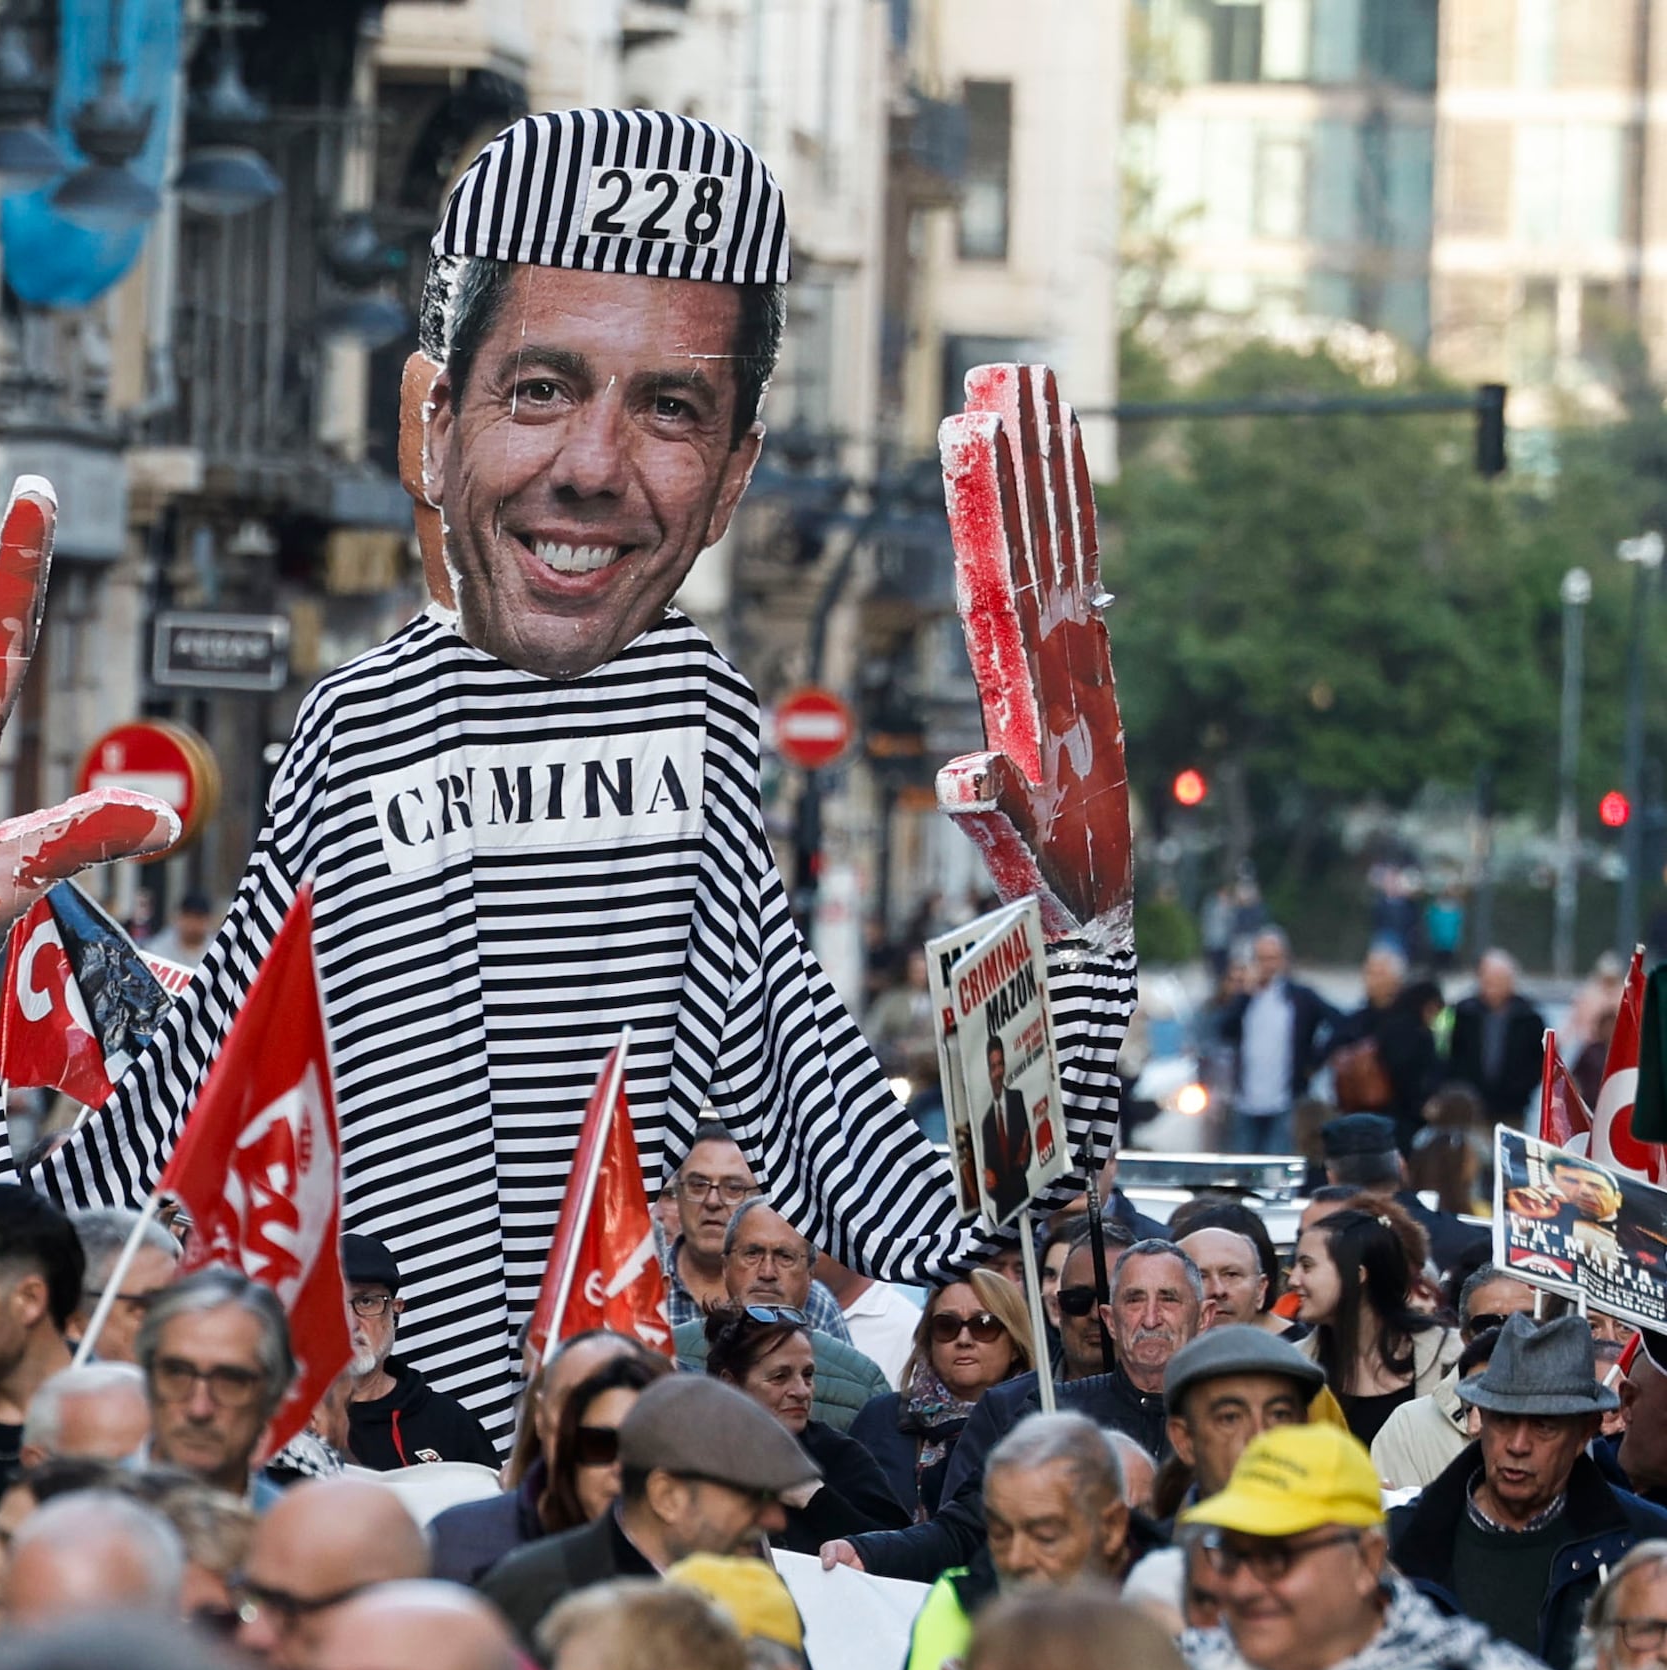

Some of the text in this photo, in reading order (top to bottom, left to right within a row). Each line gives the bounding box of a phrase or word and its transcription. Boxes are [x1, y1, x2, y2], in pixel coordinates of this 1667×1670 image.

[591, 169, 723, 245] 228
[387, 752, 705, 847] CRMINA
[959, 922, 1032, 1017] CRIMINAL
